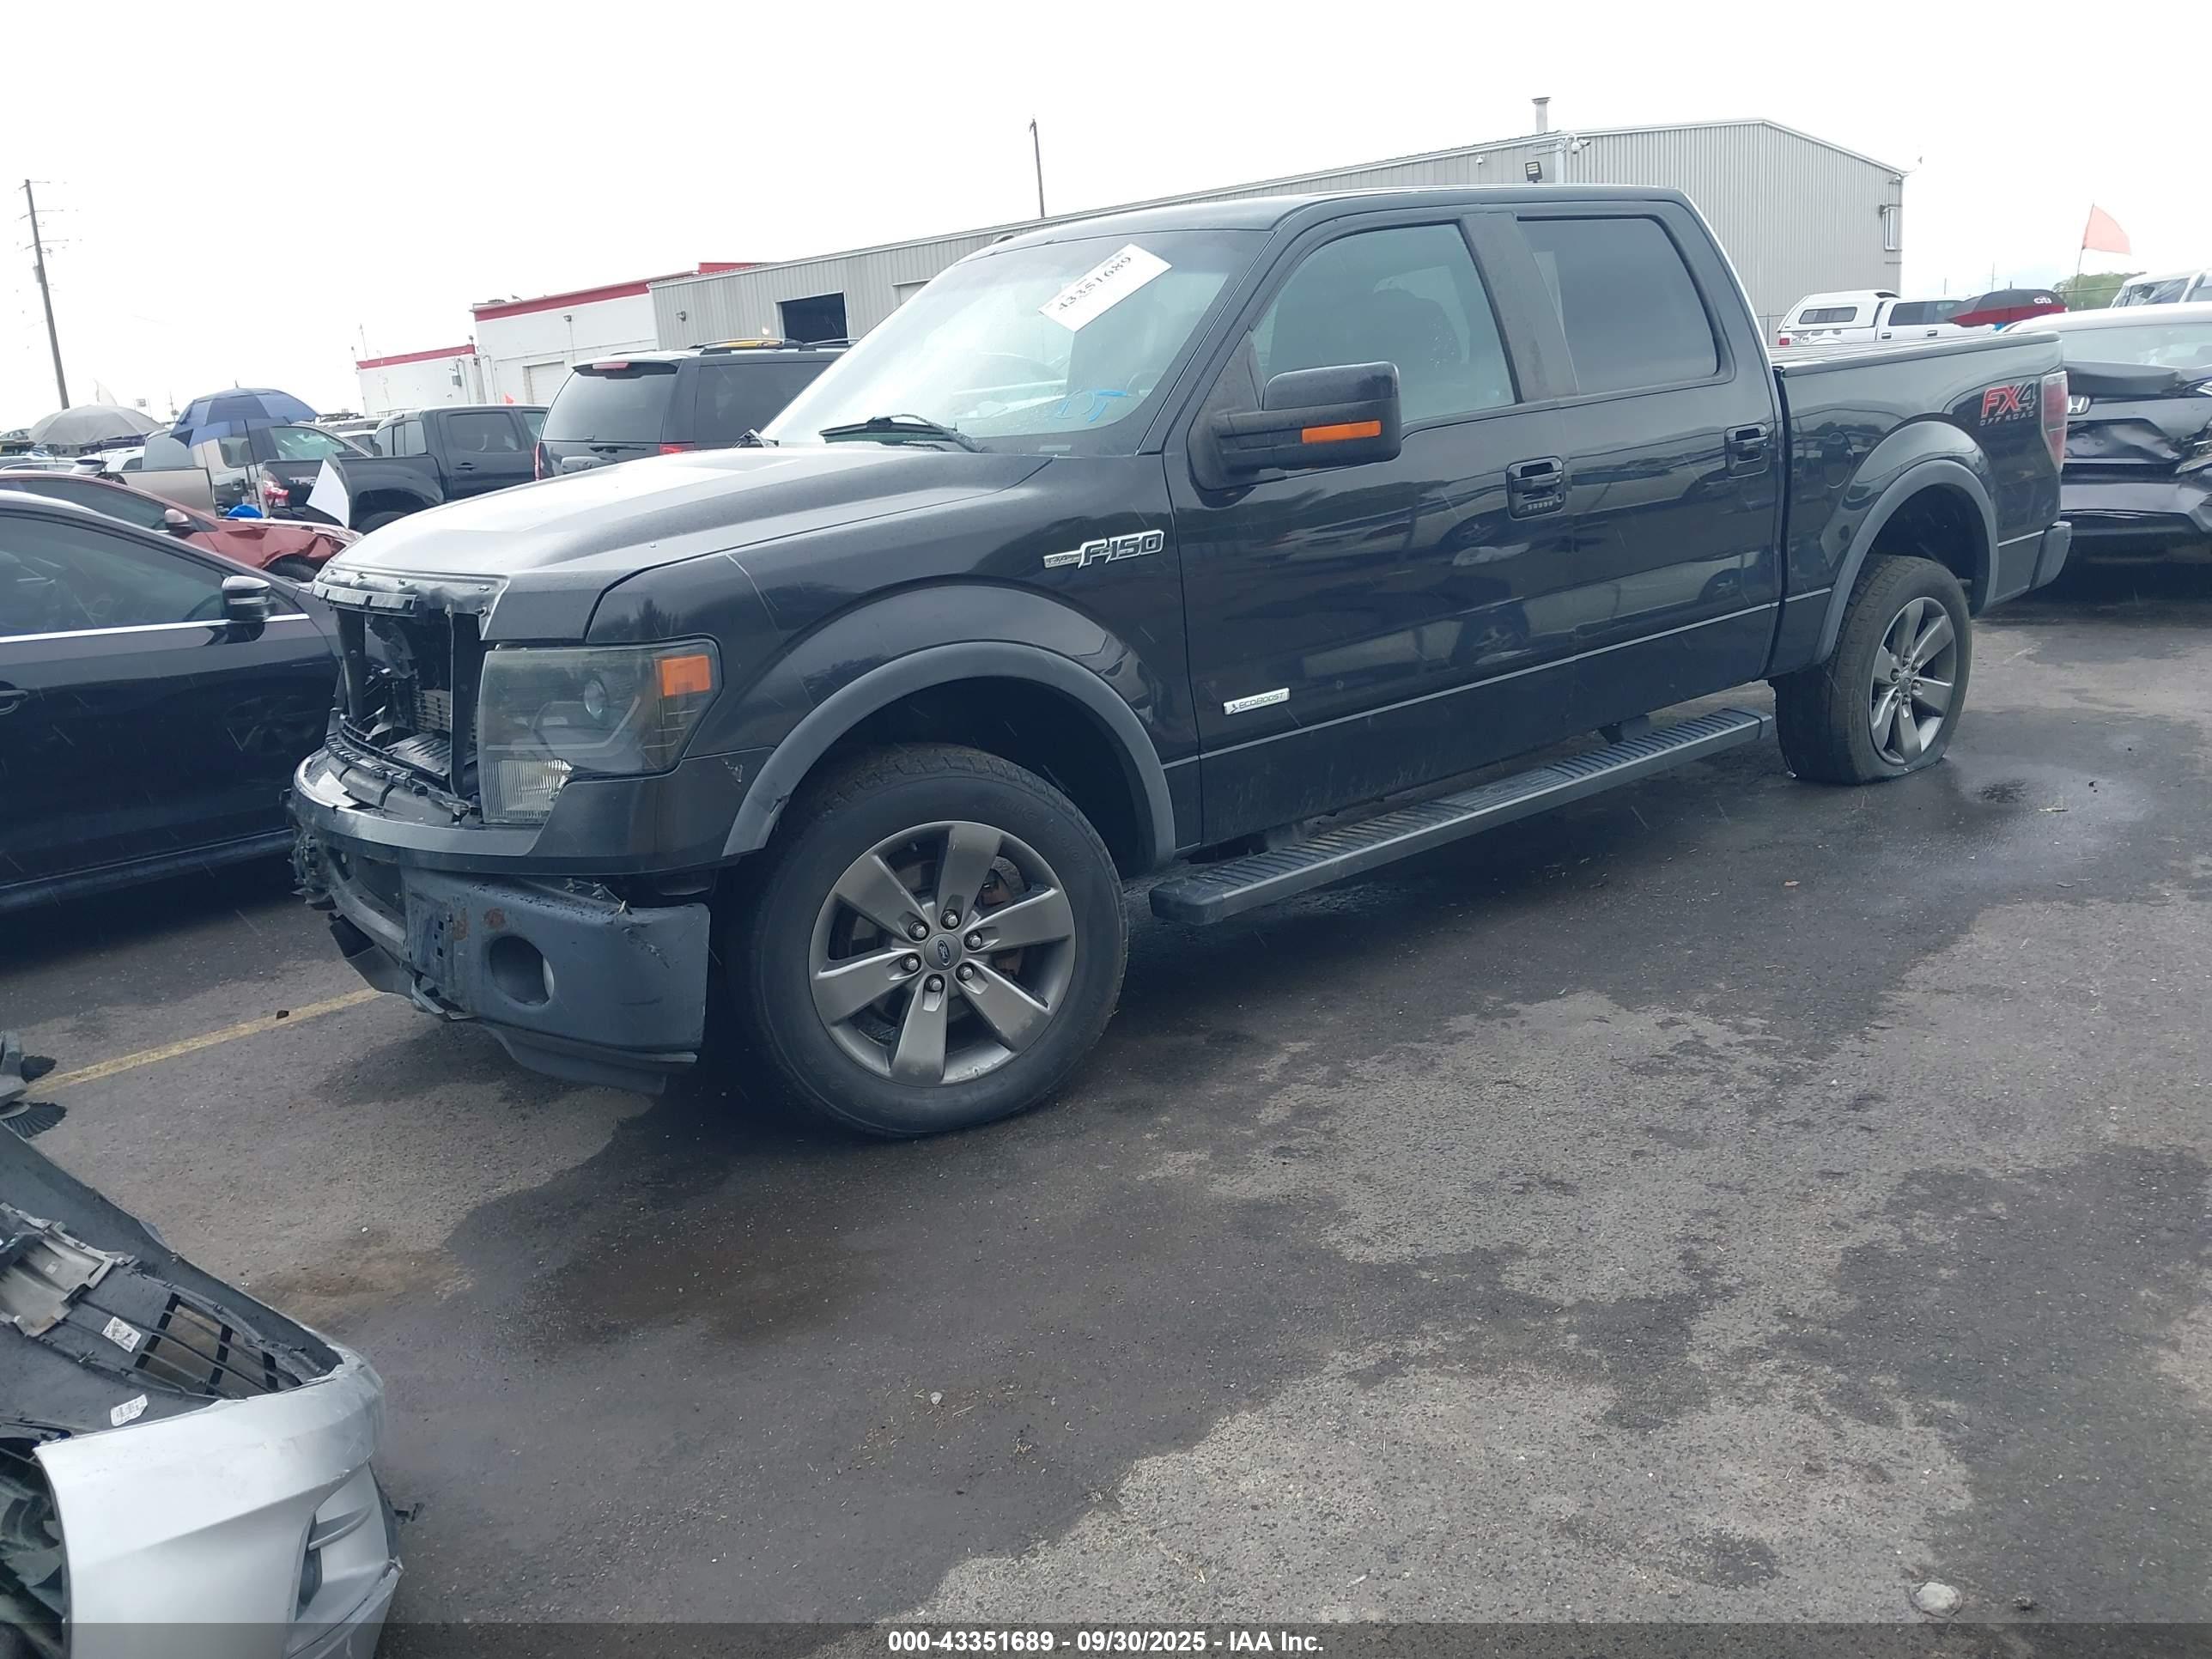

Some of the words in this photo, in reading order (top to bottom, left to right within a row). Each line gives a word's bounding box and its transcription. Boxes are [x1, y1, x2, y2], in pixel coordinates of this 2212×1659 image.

[1979, 416, 2002, 426] OFF
[2005, 410, 2034, 421] ROAD
[1981, 380, 2036, 419] FX4
[1078, 529, 1164, 569] F-150
